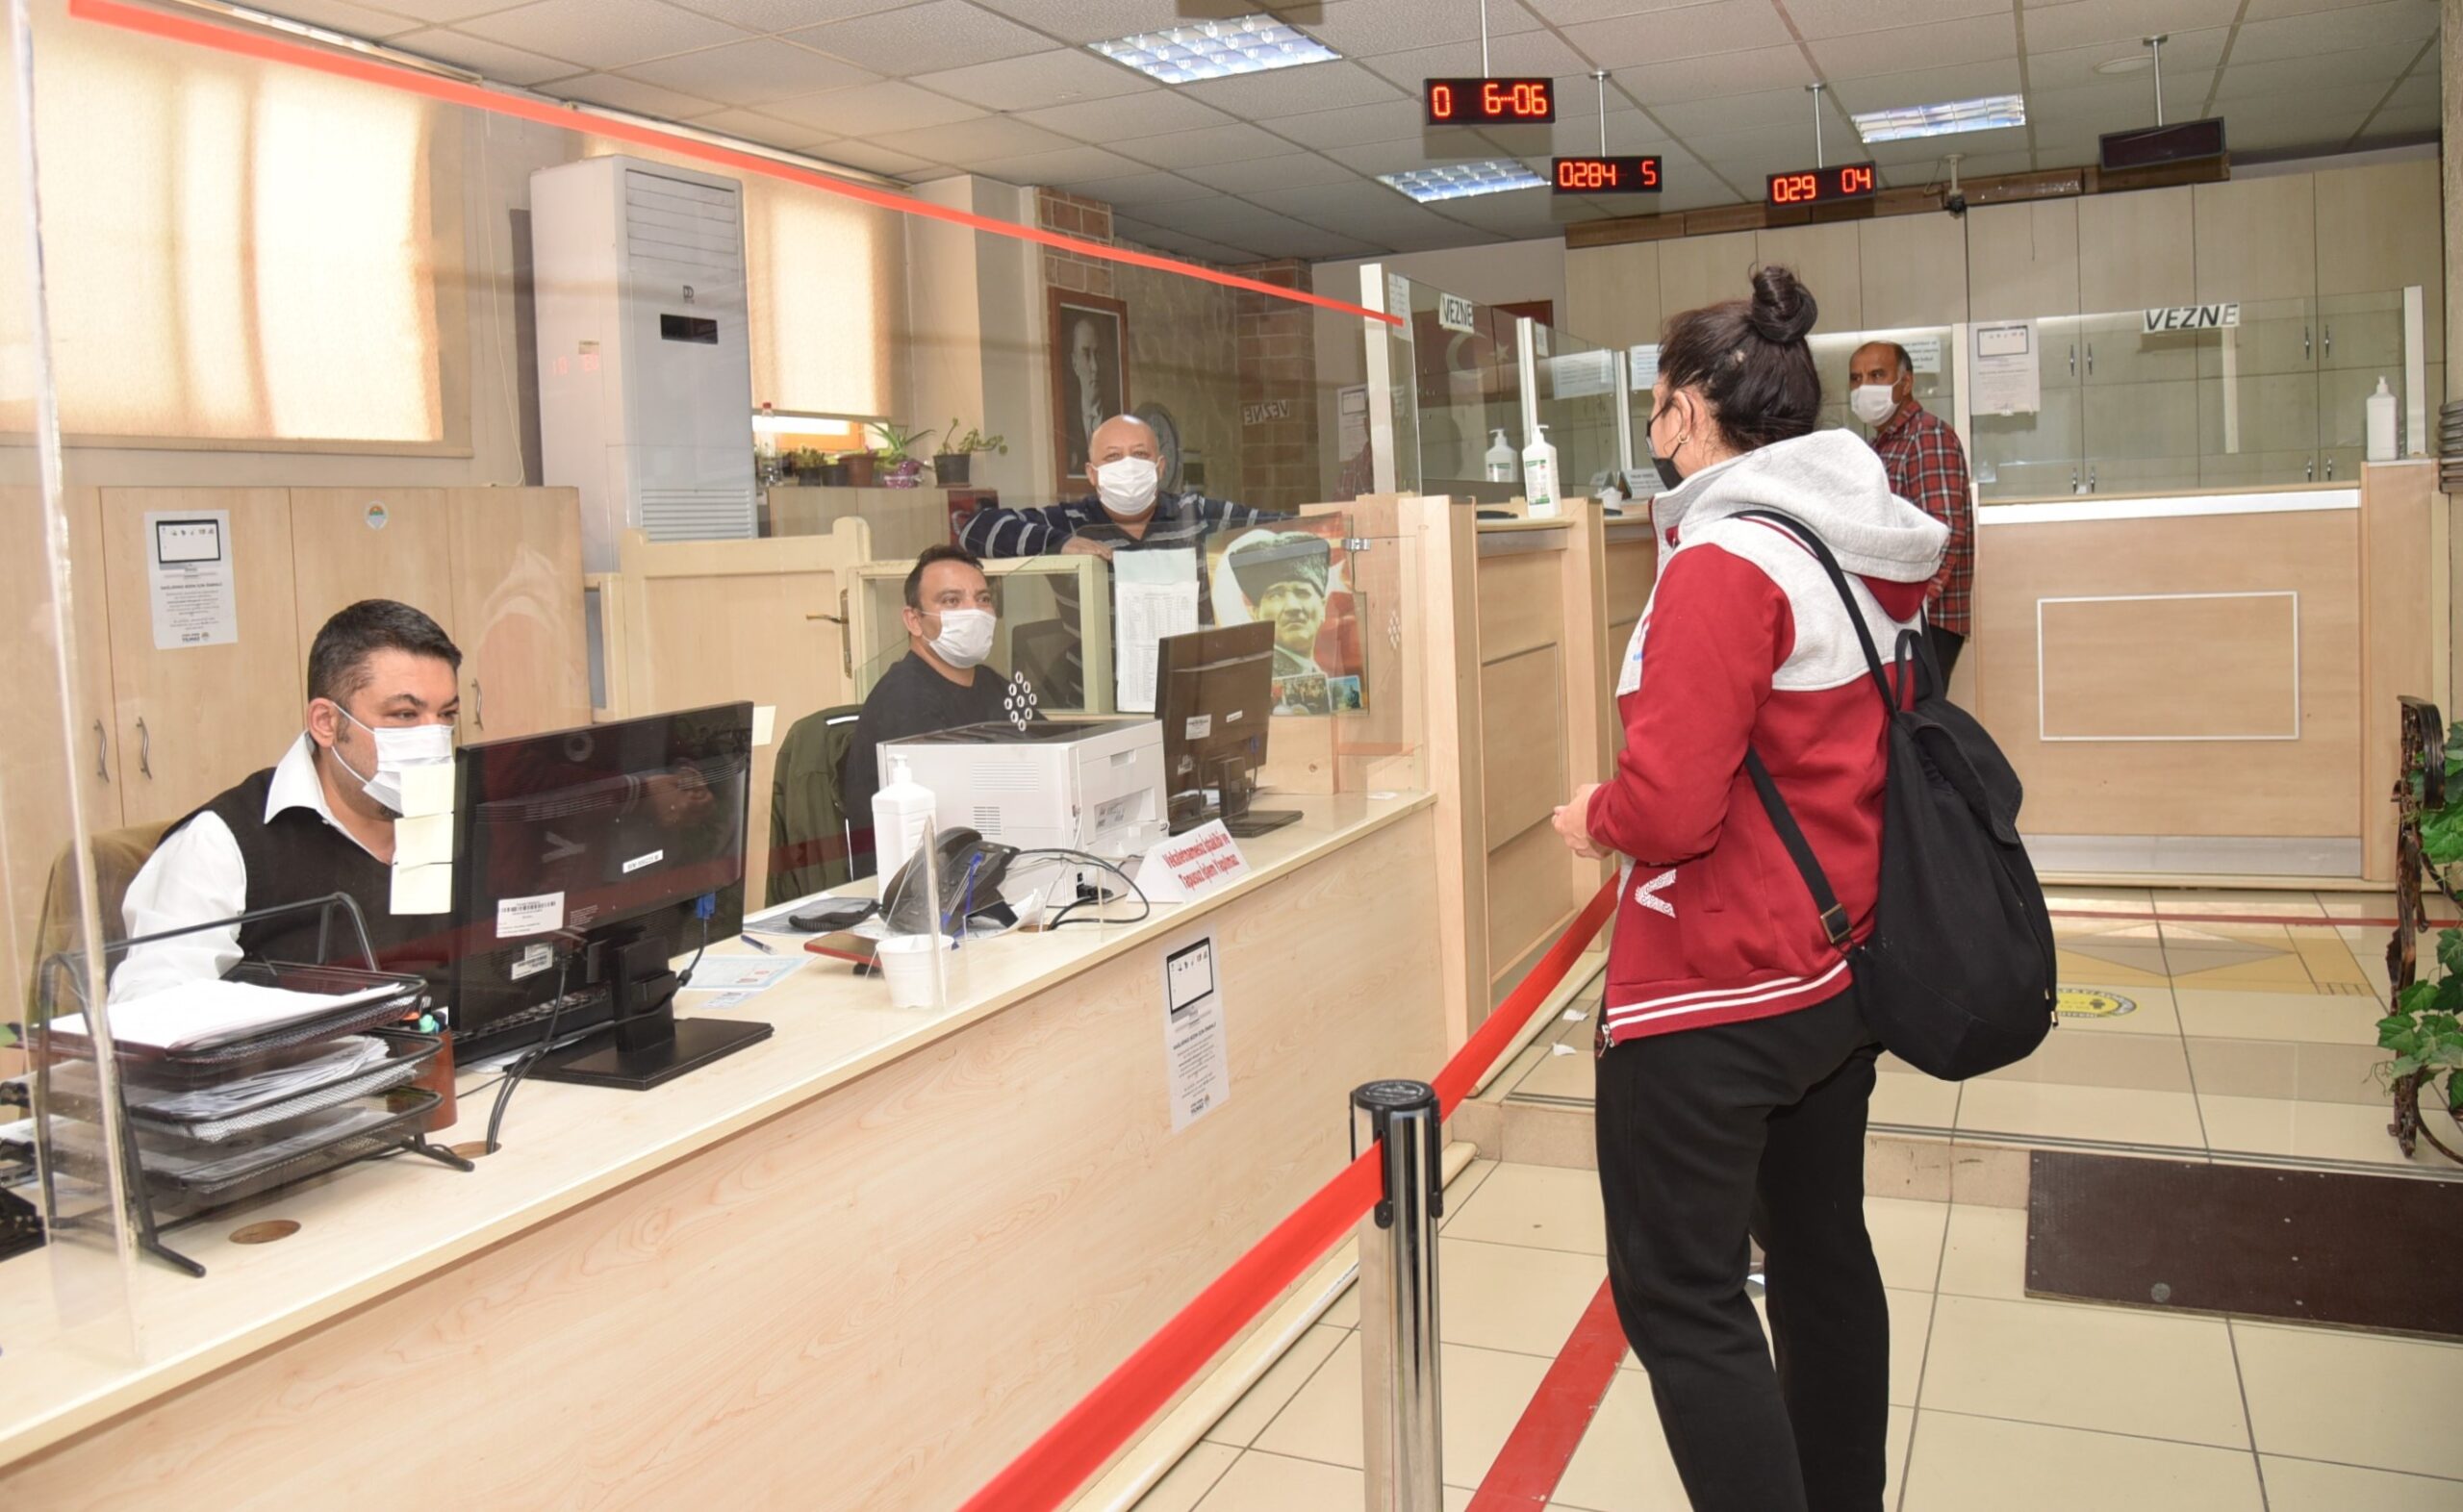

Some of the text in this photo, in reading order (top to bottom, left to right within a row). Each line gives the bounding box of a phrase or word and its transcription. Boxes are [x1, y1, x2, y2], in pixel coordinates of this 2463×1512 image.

[1433, 86, 1451, 116] 0
[1559, 162, 1617, 189] 0284
[1841, 167, 1871, 194] 04
[1442, 296, 1473, 327] VEZNE
[2145, 304, 2238, 331] VEZNE
